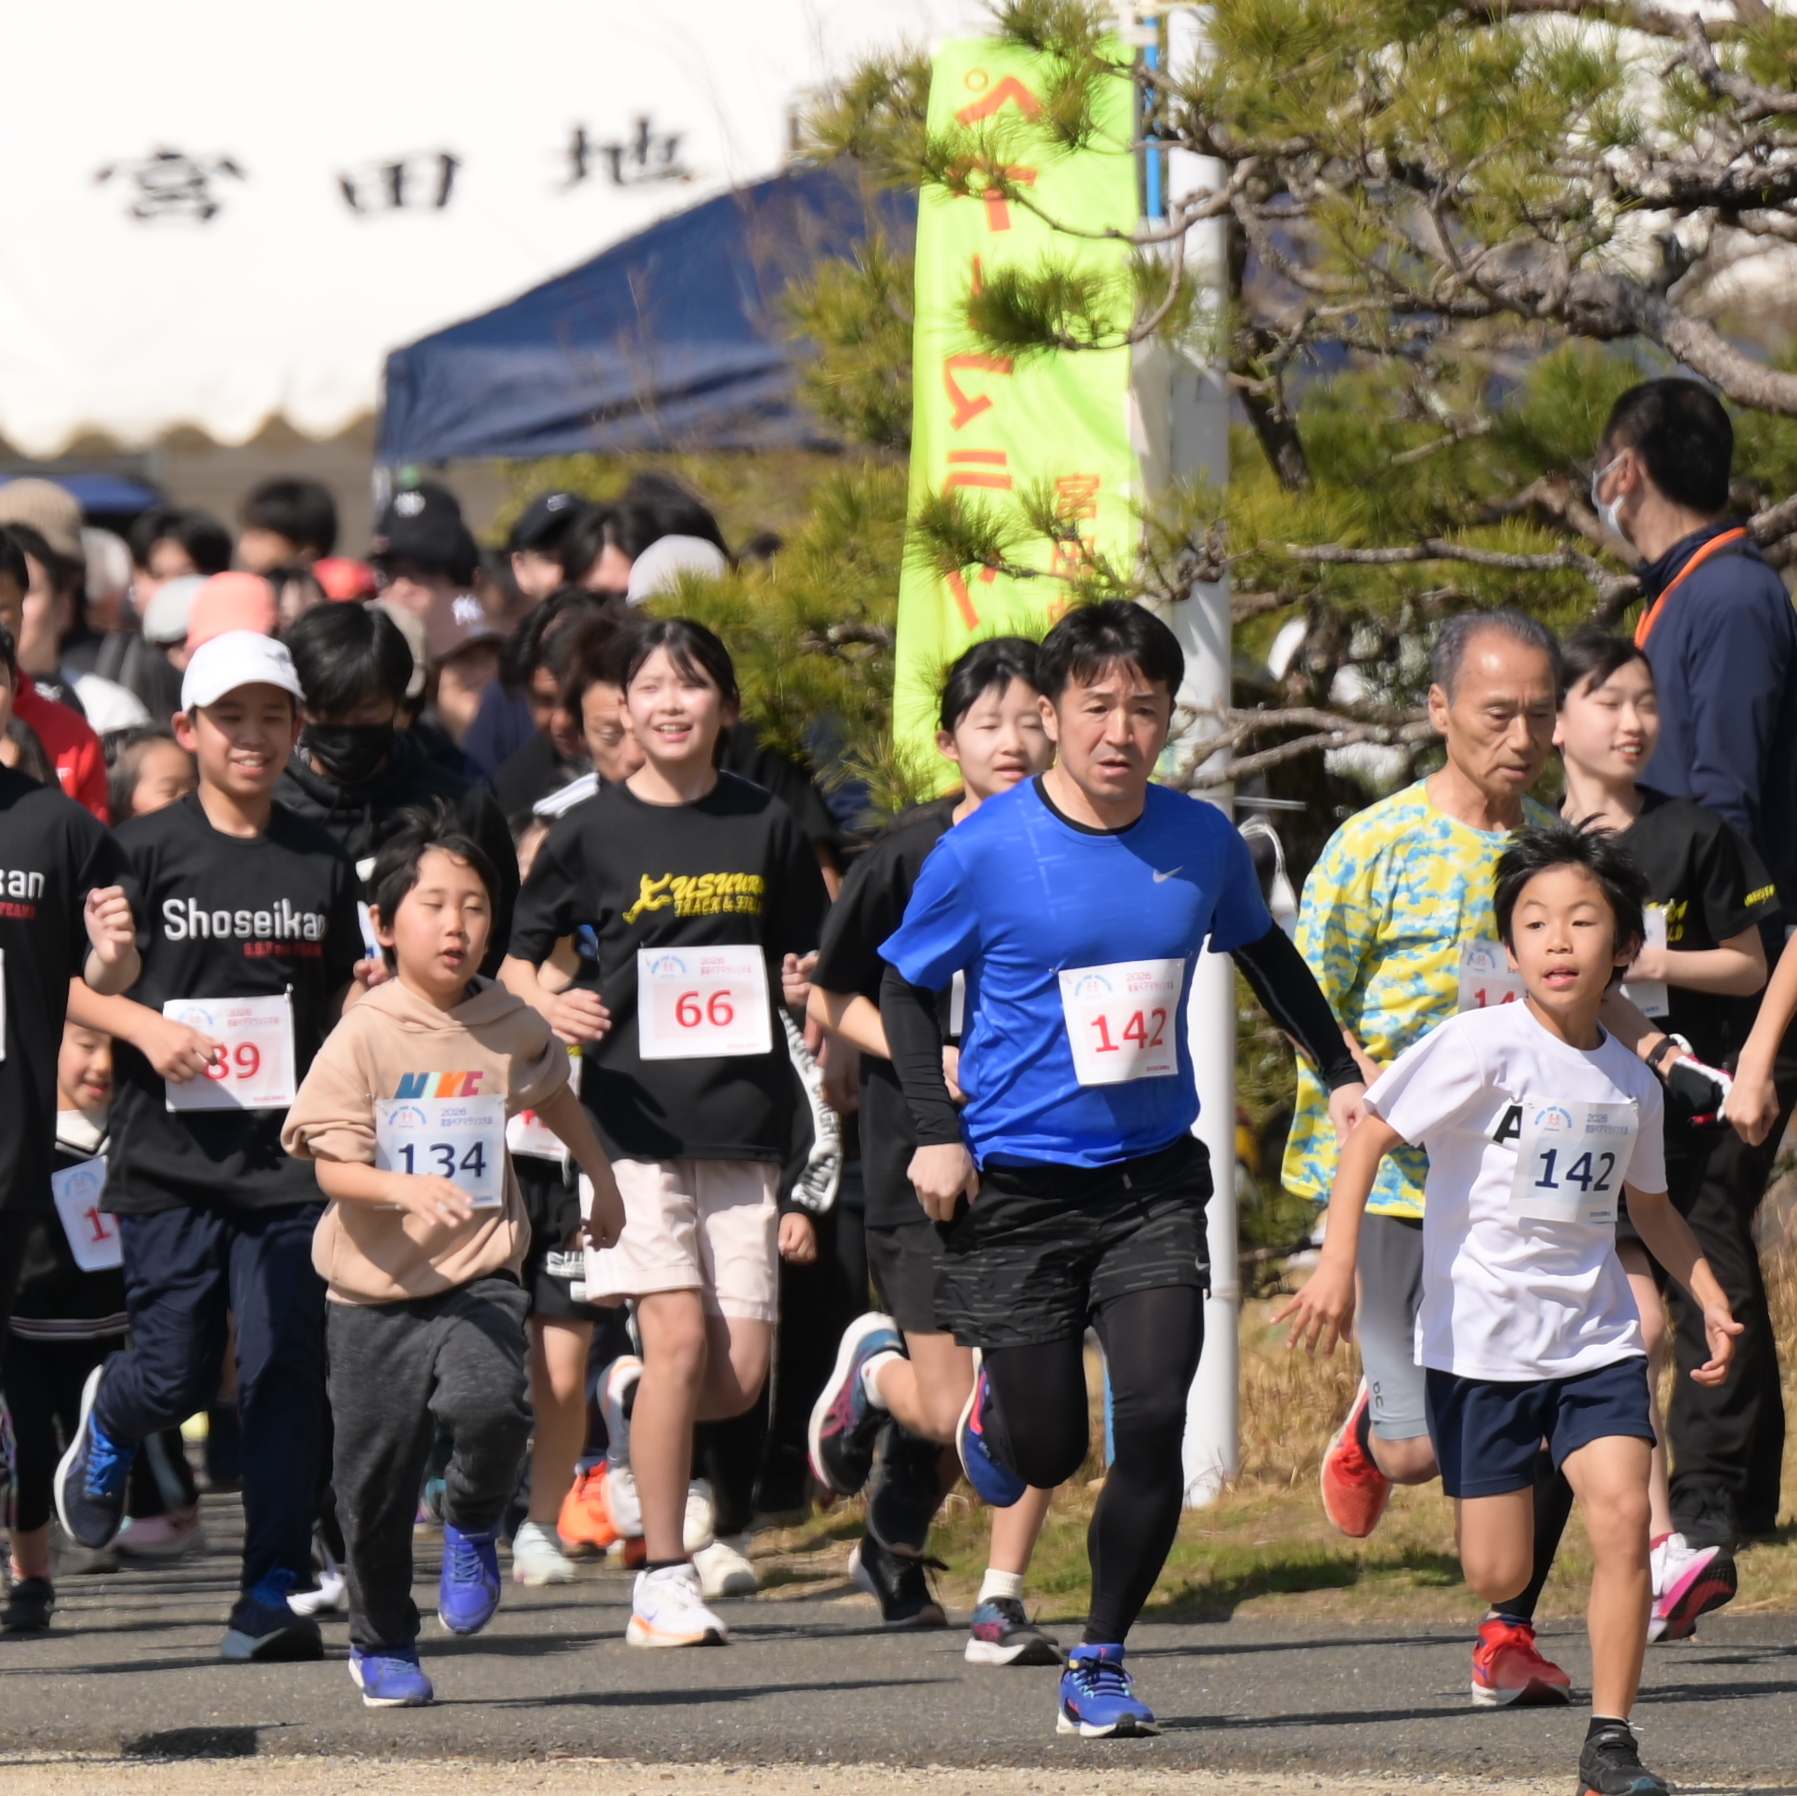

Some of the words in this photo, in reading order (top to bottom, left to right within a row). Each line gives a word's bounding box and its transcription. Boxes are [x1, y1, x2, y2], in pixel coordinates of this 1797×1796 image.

[674, 989, 734, 1028] 66
[1090, 1007, 1167, 1053] 142
[395, 1071, 484, 1100] NIKE
[398, 1141, 487, 1179] 134
[1534, 1148, 1616, 1192] 142
